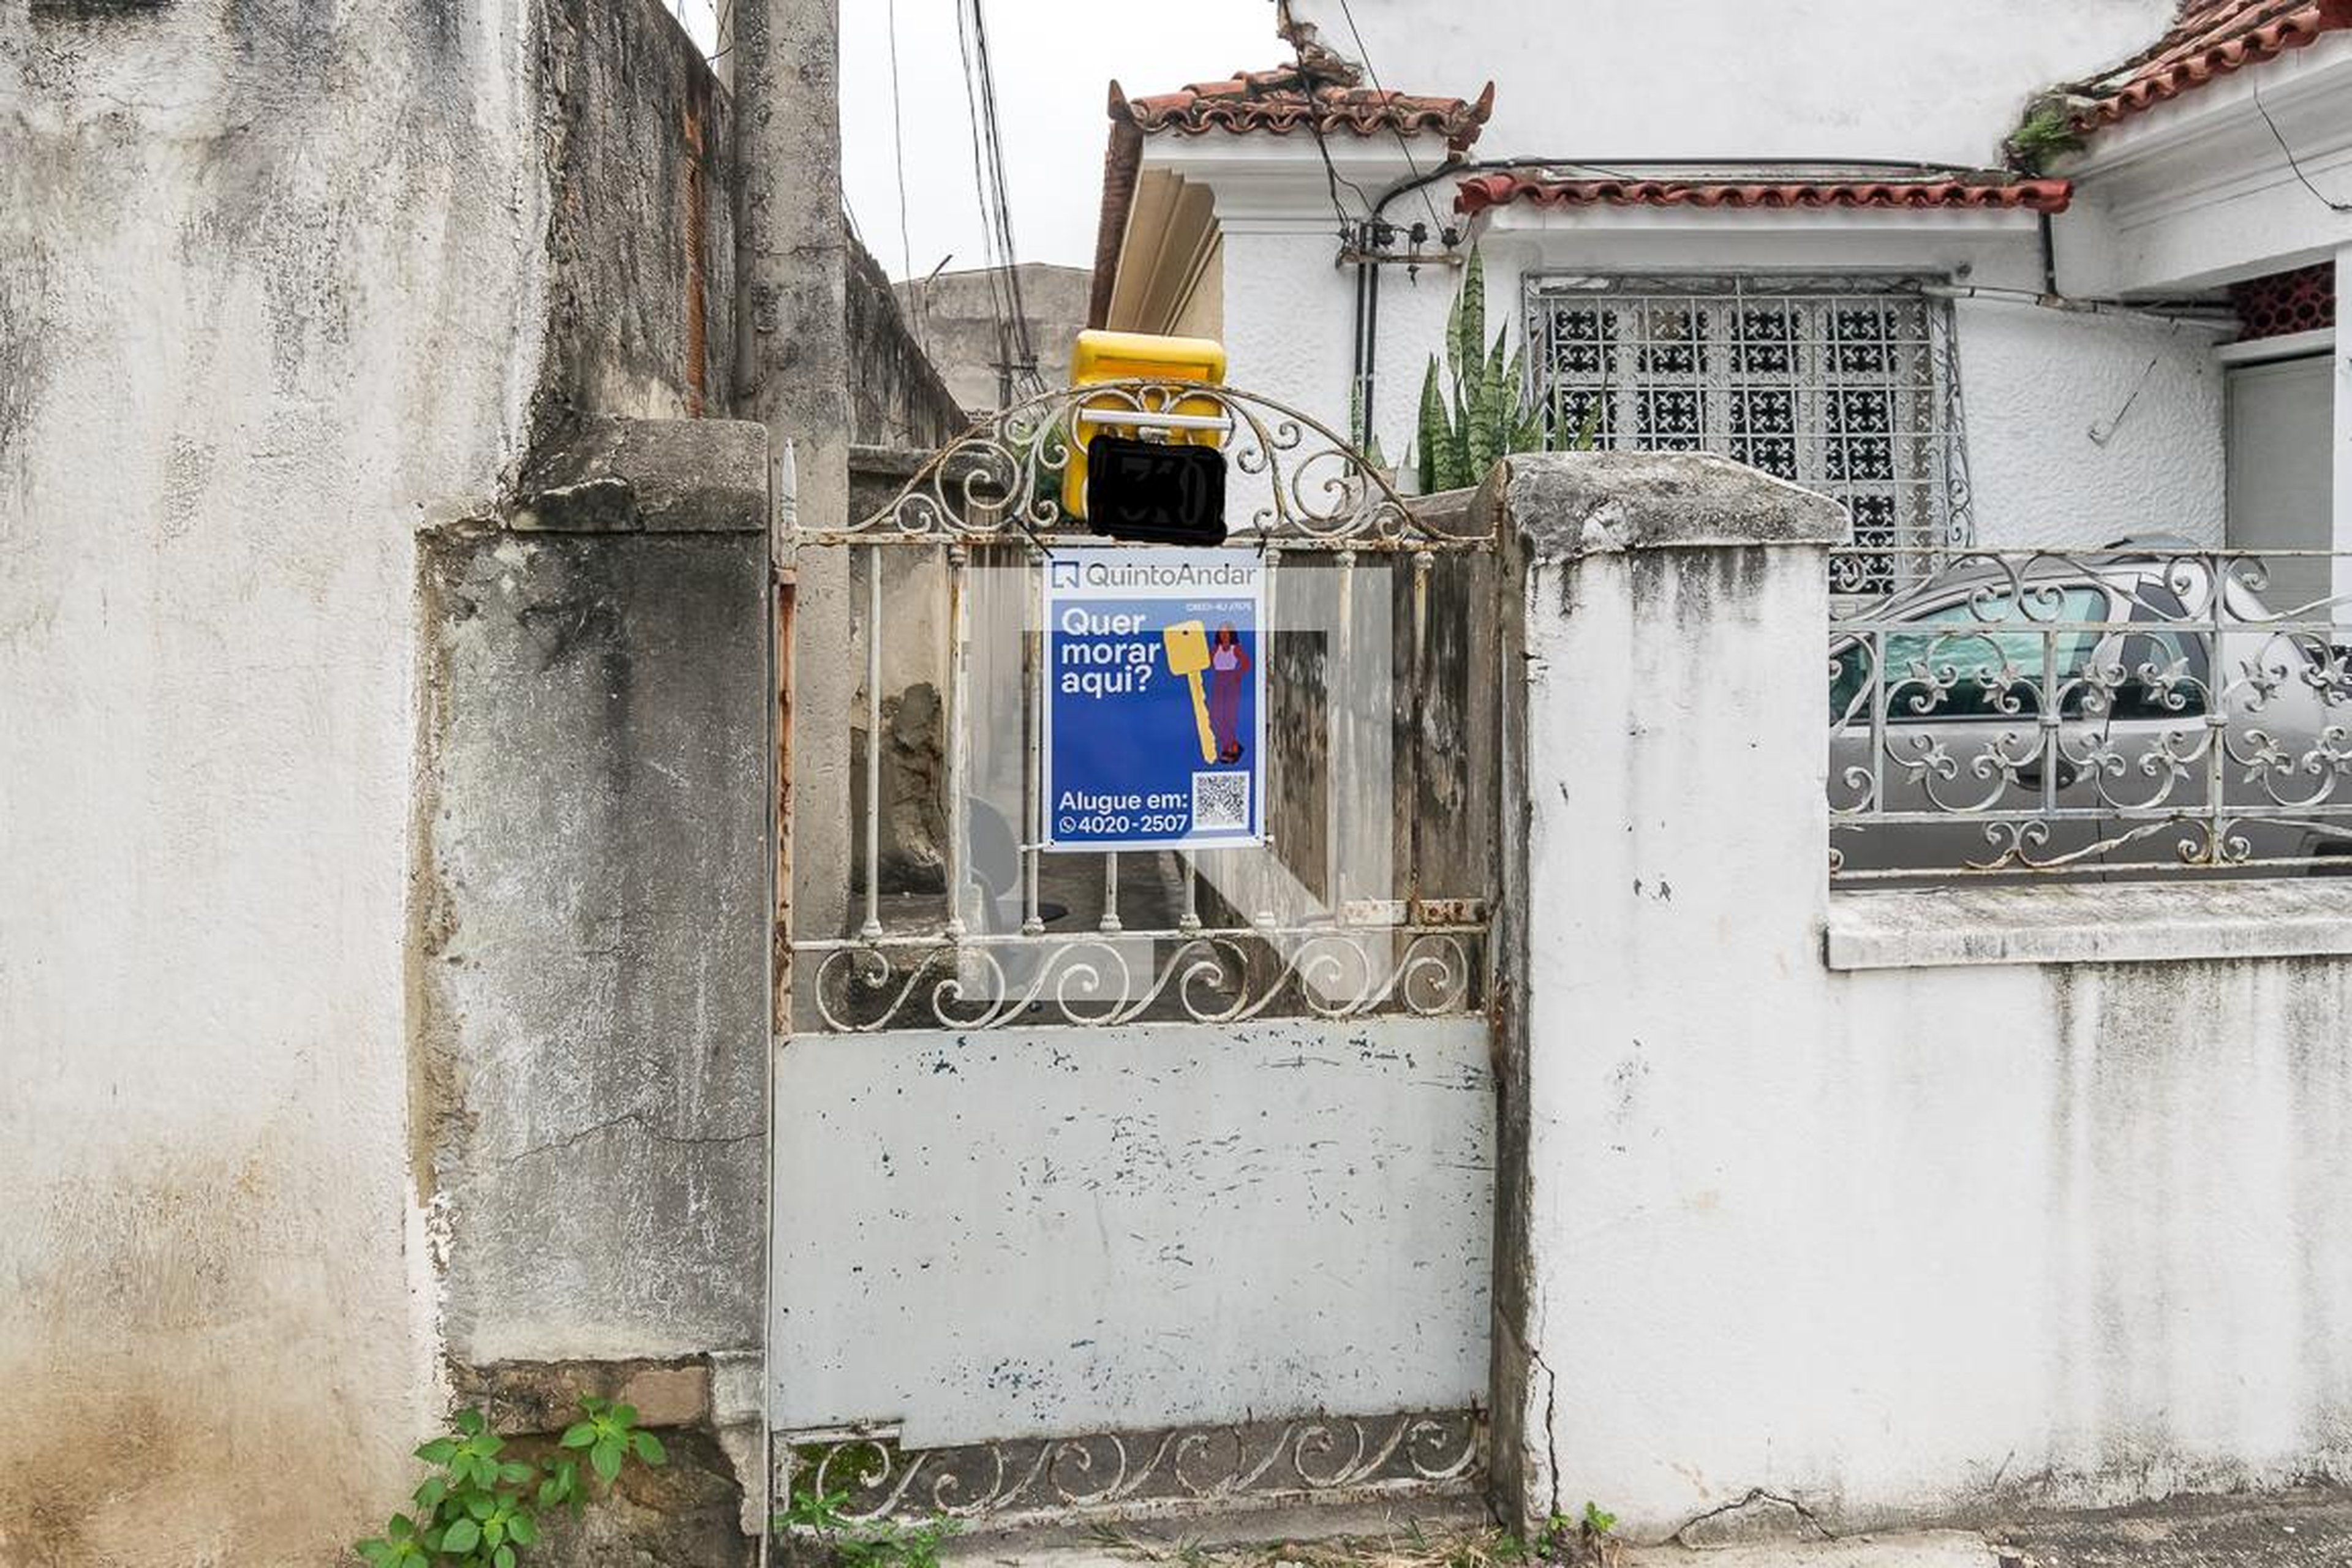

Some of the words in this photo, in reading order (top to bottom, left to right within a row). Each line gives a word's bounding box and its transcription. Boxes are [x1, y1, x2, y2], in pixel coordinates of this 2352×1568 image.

[1087, 563, 1256, 586] QuintoAndar
[1062, 608, 1145, 635] Quer
[1062, 643, 1159, 664] morar
[1062, 665, 1152, 698] aqui?
[1060, 792, 1141, 815] Alugue
[1148, 794, 1188, 809] em:
